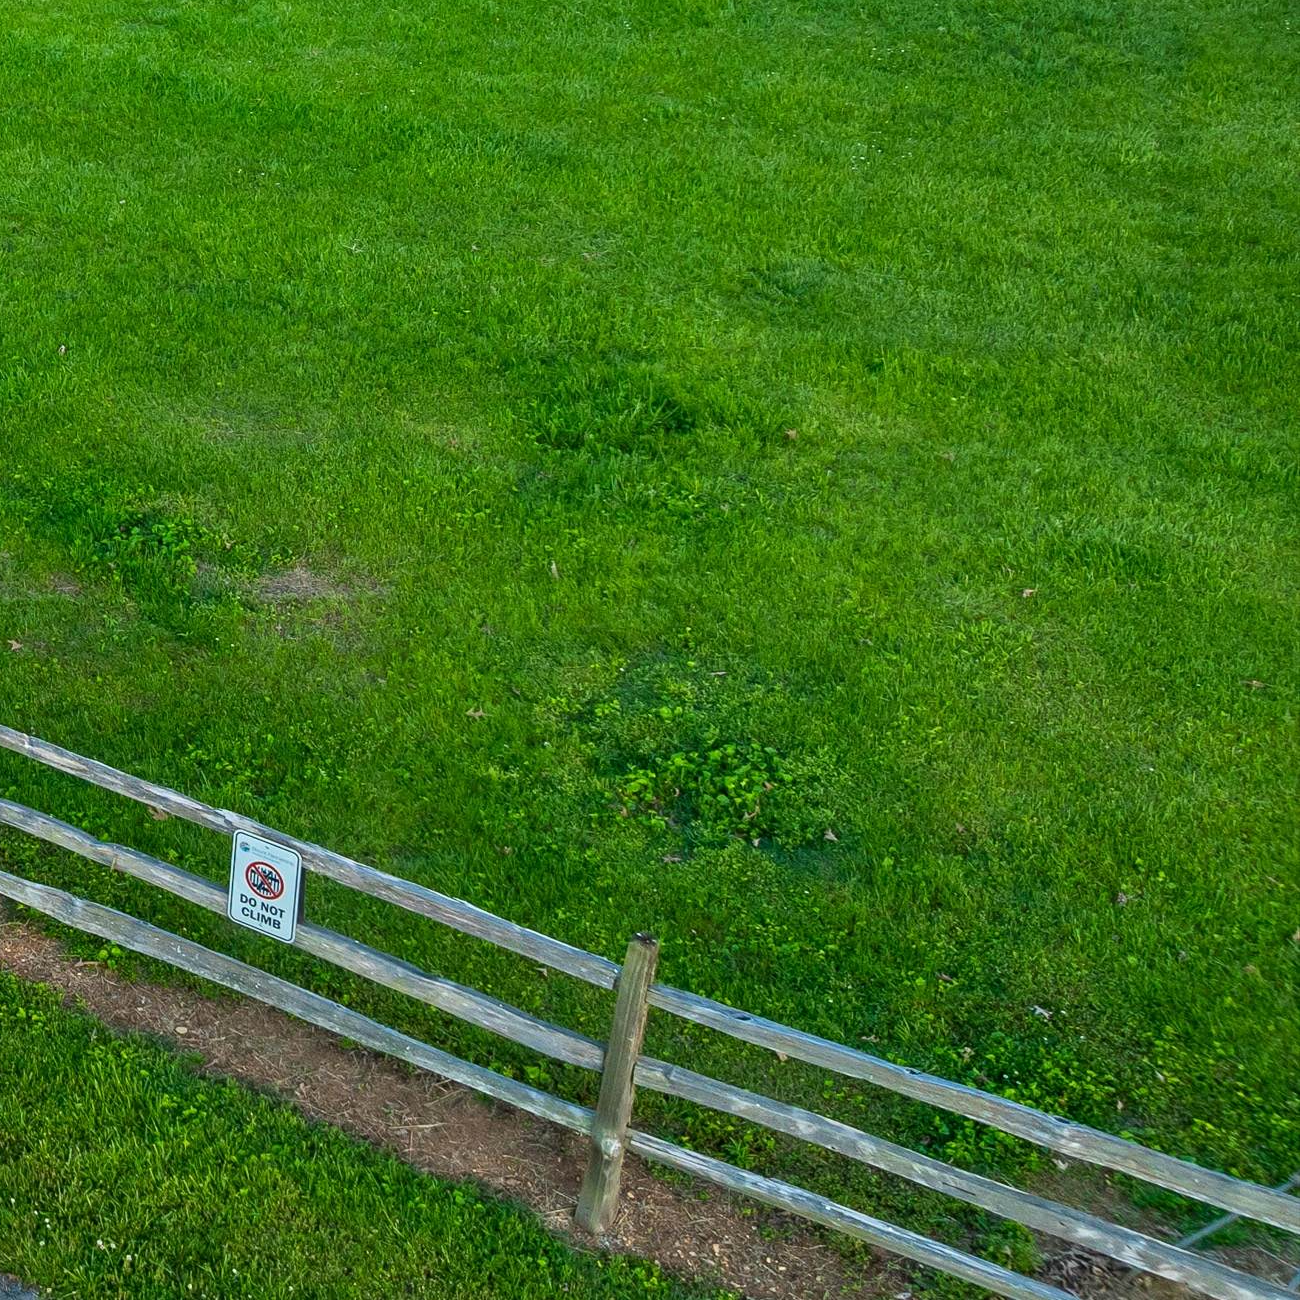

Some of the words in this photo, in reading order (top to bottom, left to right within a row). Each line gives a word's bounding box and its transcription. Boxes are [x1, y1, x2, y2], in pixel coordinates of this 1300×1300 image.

[240, 893, 257, 908] DO
[261, 901, 286, 919] NOT
[241, 906, 281, 930] CLIMB
